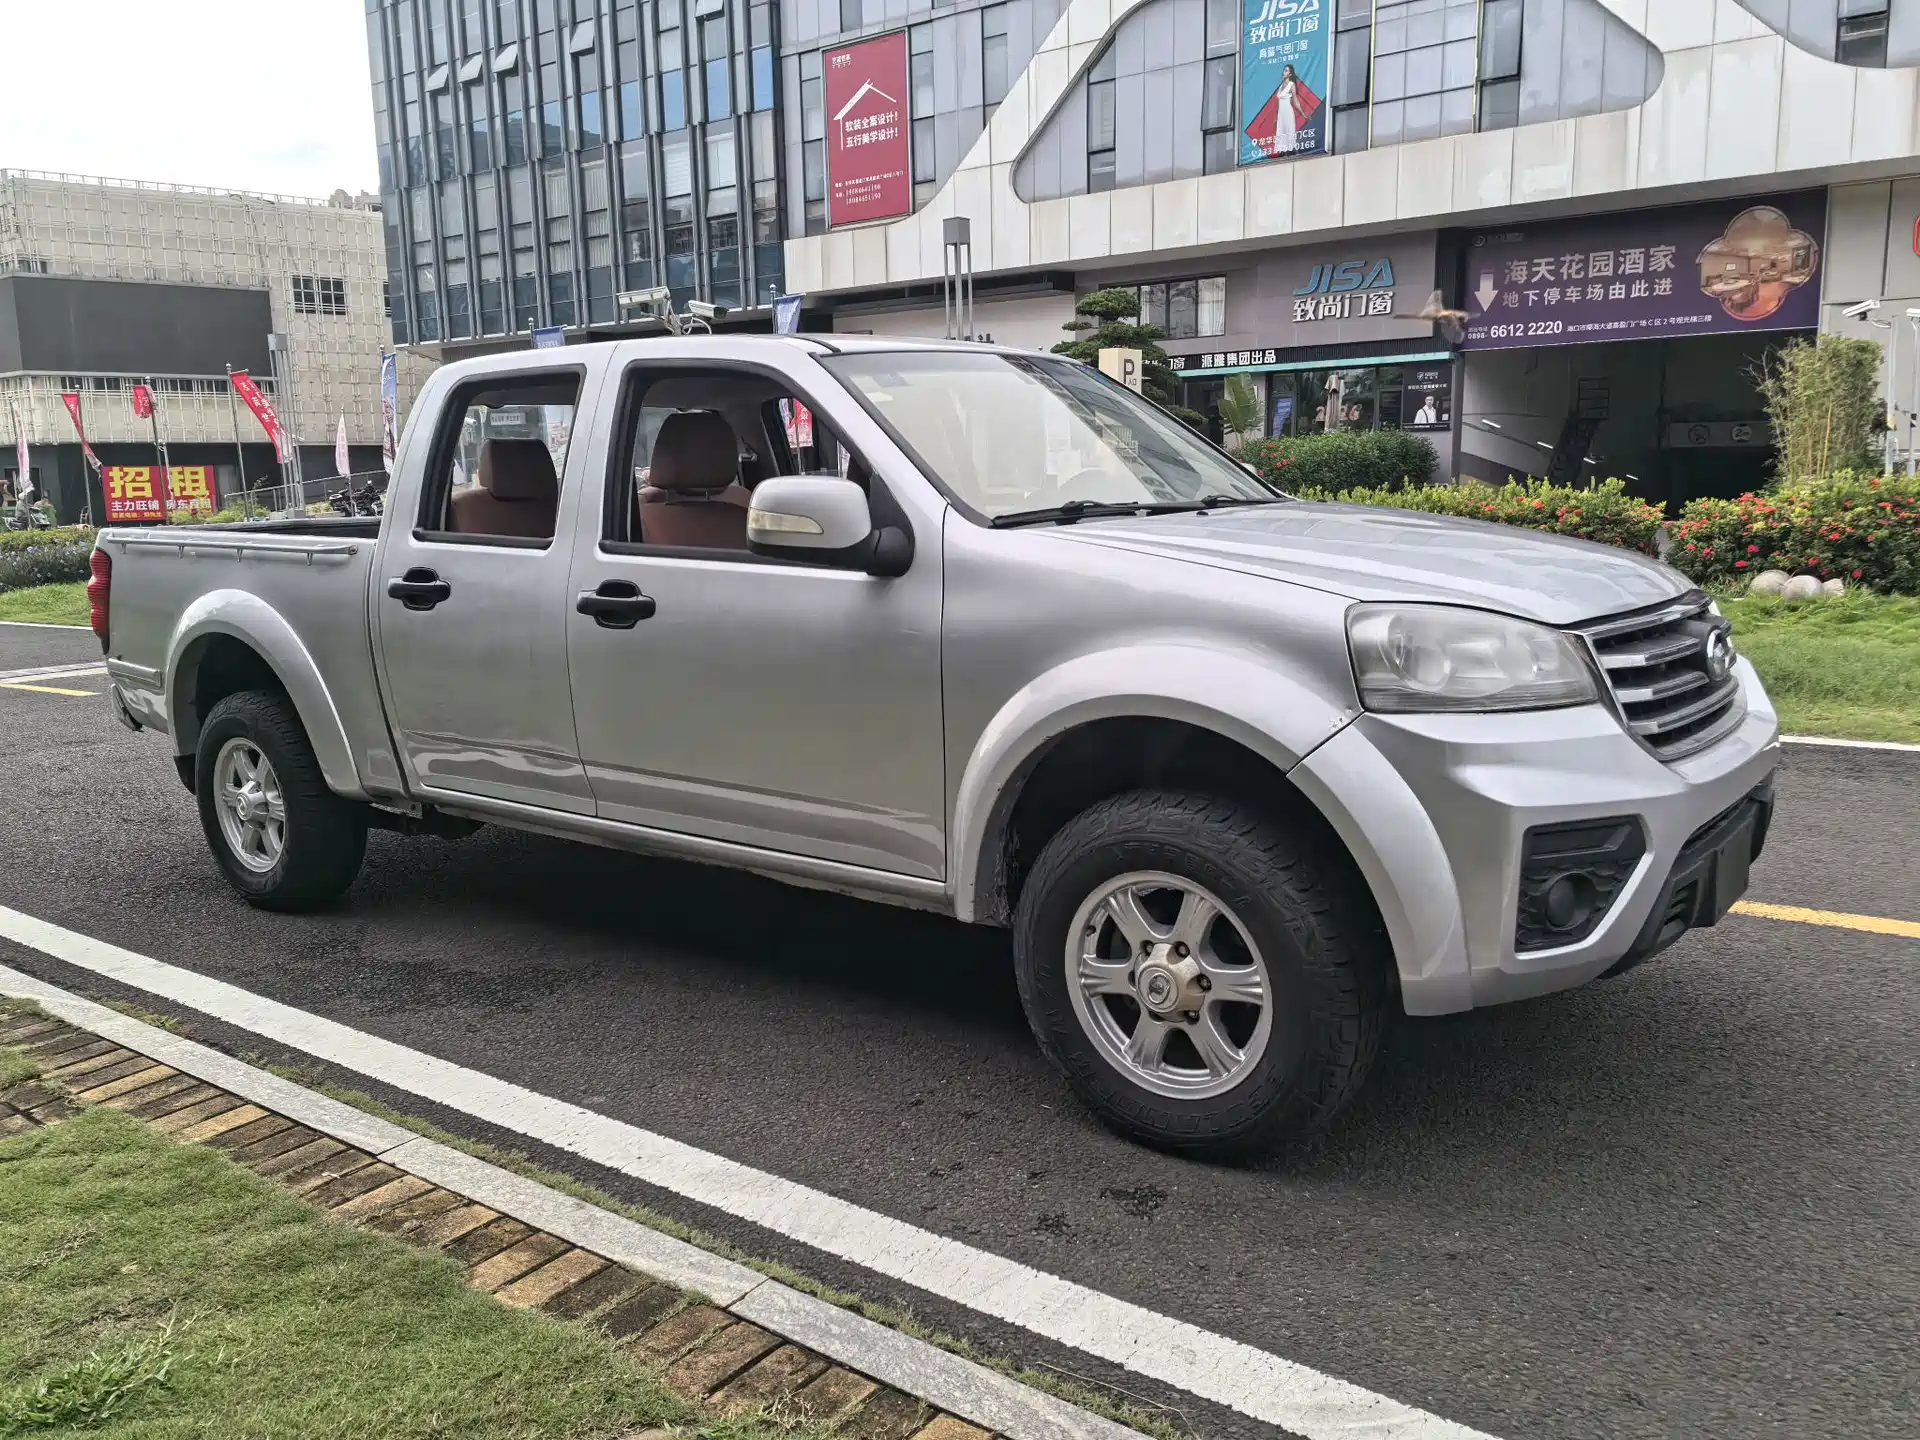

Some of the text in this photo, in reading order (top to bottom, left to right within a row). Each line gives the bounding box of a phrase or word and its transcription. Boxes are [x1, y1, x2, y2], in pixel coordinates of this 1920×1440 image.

[1249, 0, 1320, 25] JISA
[1249, 13, 1320, 45] 致尚门窗
[1292, 257, 1395, 295] JISA
[1503, 245, 1676, 284] 海天花园酒家
[1292, 290, 1394, 323] 致尚门窗
[1502, 277, 1673, 308] 地下停车场由此进
[1490, 324, 1524, 338] 6612
[1527, 320, 1563, 336] 2220
[1124, 359, 1135, 384] P
[111, 500, 160, 512] 主力旺铺
